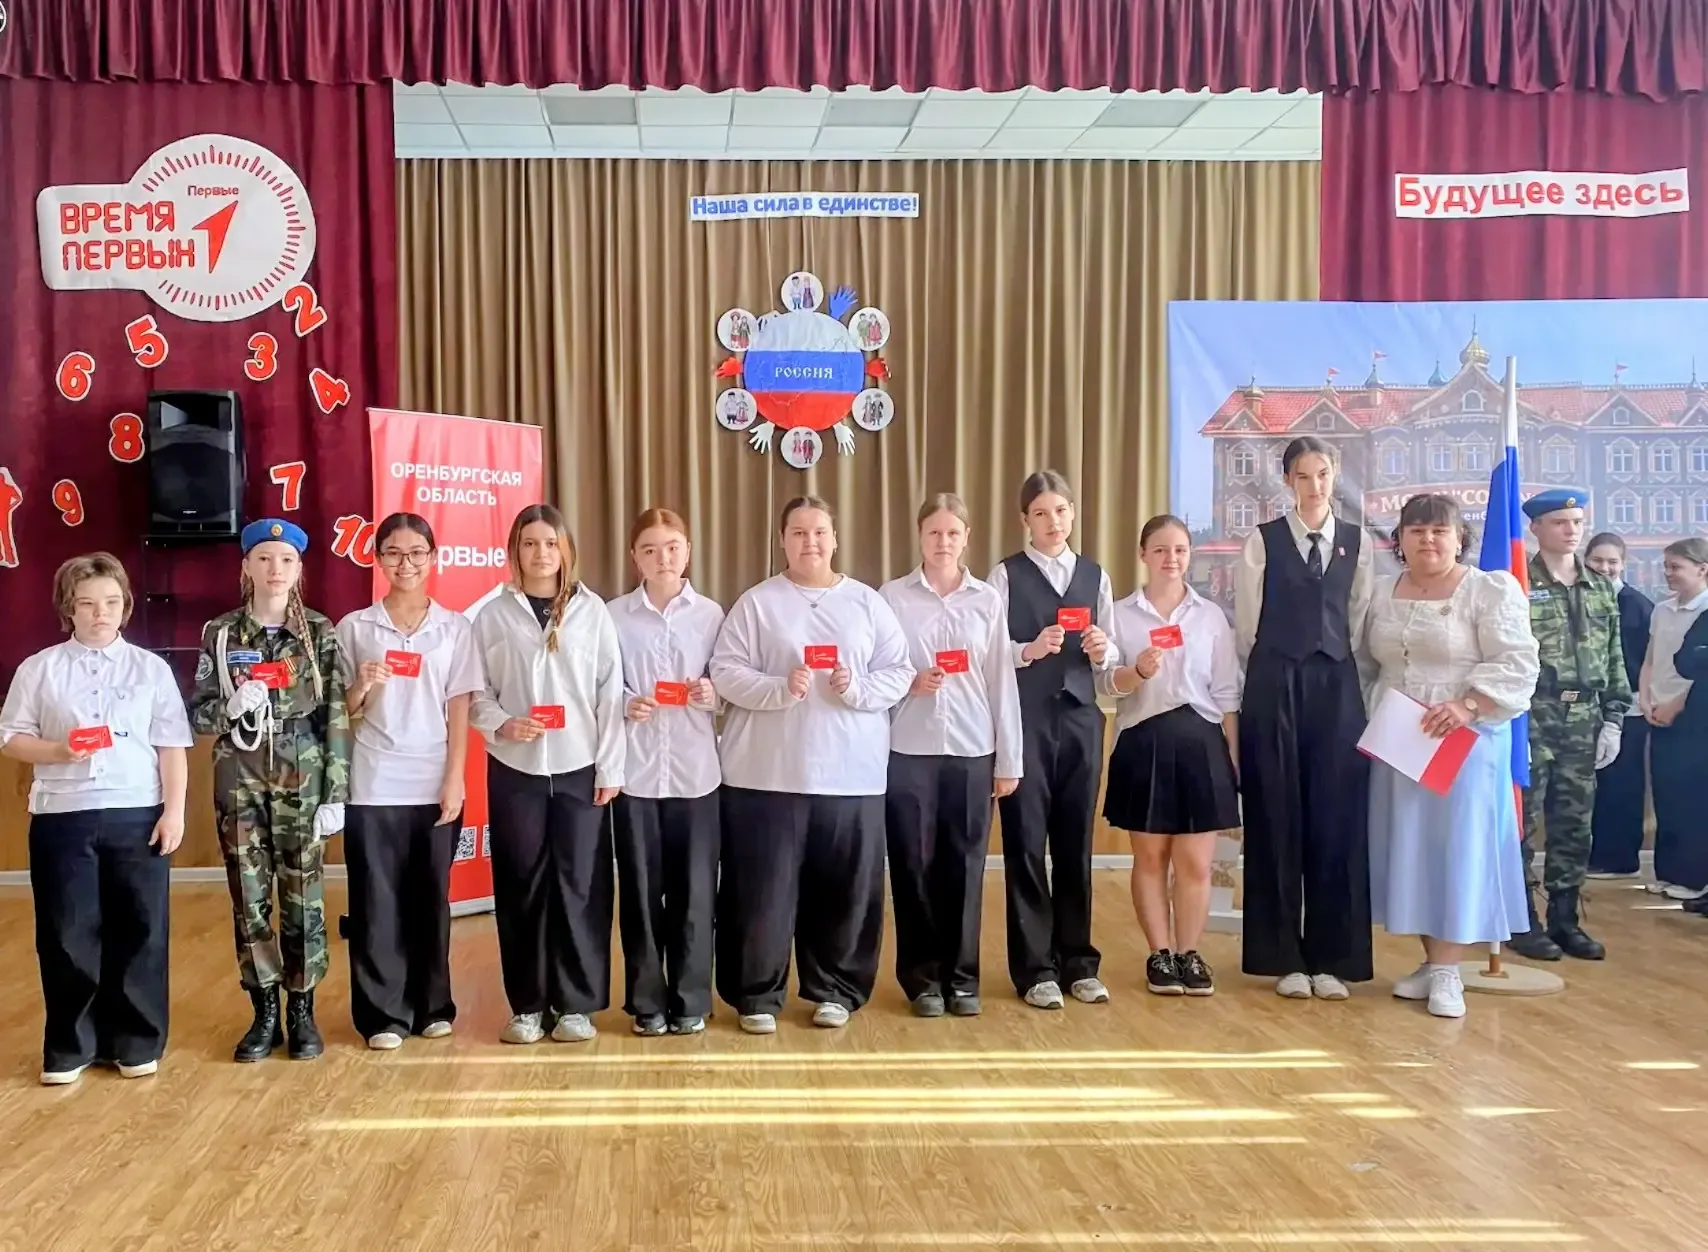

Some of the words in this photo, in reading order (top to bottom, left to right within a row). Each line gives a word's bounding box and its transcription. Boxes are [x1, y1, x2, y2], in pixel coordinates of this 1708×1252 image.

[187, 184, 239, 199] Первые
[692, 197, 748, 215] Наша
[753, 196, 800, 212] сила
[803, 196, 813, 210] в
[818, 195, 918, 215] единстве!
[1399, 177, 1565, 215] Будущее
[1575, 181, 1685, 211] здесь
[60, 201, 175, 234] ВРЕМЯ
[282, 281, 327, 337] 2
[125, 314, 168, 367] 5
[244, 332, 278, 381] 3
[56, 351, 95, 401] 6
[309, 368, 350, 414] 4
[775, 366, 833, 379] РОССИЯ
[109, 412, 145, 463] 8
[270, 461, 305, 511] 7
[390, 462, 522, 487] ОРЕНБУРГСКАЯ
[416, 486, 497, 506] ОБЛАСТЬ
[52, 479, 84, 526] 9
[331, 514, 375, 567] 10
[437, 545, 506, 575] рвые
